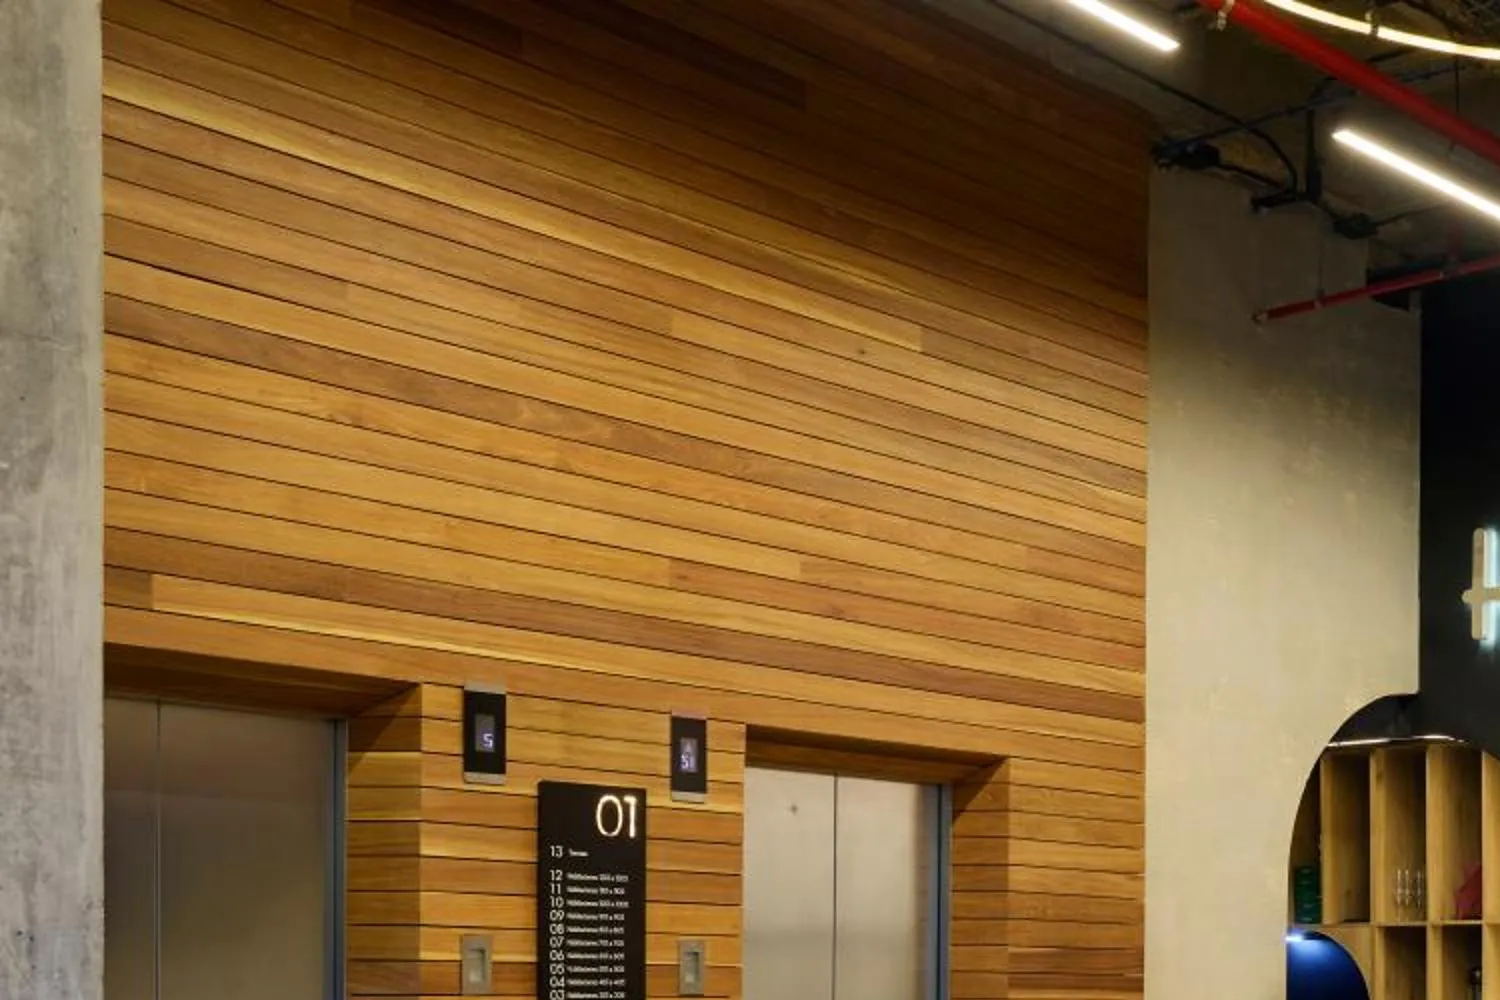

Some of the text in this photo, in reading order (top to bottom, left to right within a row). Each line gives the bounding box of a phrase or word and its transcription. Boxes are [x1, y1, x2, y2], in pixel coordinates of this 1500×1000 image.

[596, 794, 638, 839] 01
[549, 845, 564, 858] 13
[549, 869, 564, 881] 12
[549, 883, 562, 895] 11
[549, 895, 565, 908] 10
[549, 909, 565, 921] 09
[549, 923, 565, 935] 08
[549, 936, 565, 948] 07
[549, 949, 565, 961] 06
[549, 962, 565, 975] 05
[549, 976, 565, 988] 04
[549, 989, 565, 1000] 03
